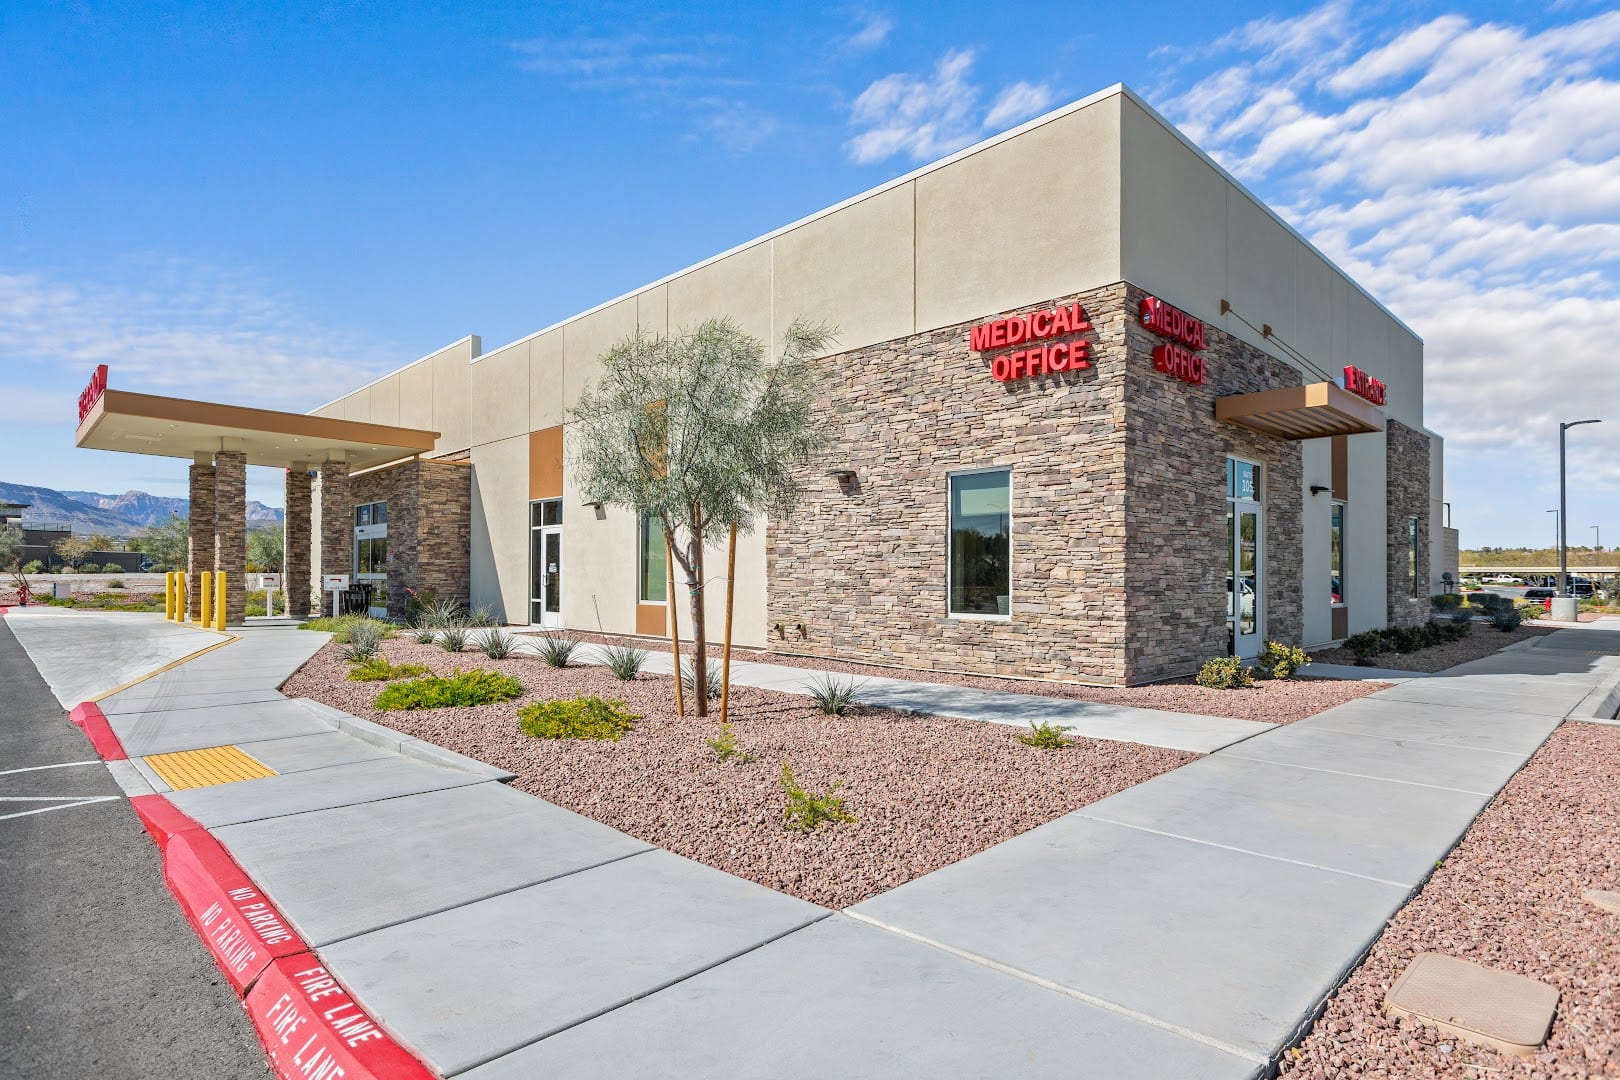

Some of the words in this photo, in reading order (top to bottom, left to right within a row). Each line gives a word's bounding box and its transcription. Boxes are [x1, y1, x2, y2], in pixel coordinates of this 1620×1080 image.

[969, 303, 1090, 352] MEDICAL
[1145, 297, 1208, 350] MEDICAL
[991, 340, 1090, 382] OFFICE
[1163, 342, 1208, 386] OFFICE
[200, 901, 223, 927] NO
[228, 886, 257, 901] NO
[211, 917, 257, 973] PARKING
[239, 902, 292, 945] PARKING
[265, 993, 307, 1045] FIRE
[294, 967, 343, 1002] FIRE
[324, 1002, 383, 1048] LANE
